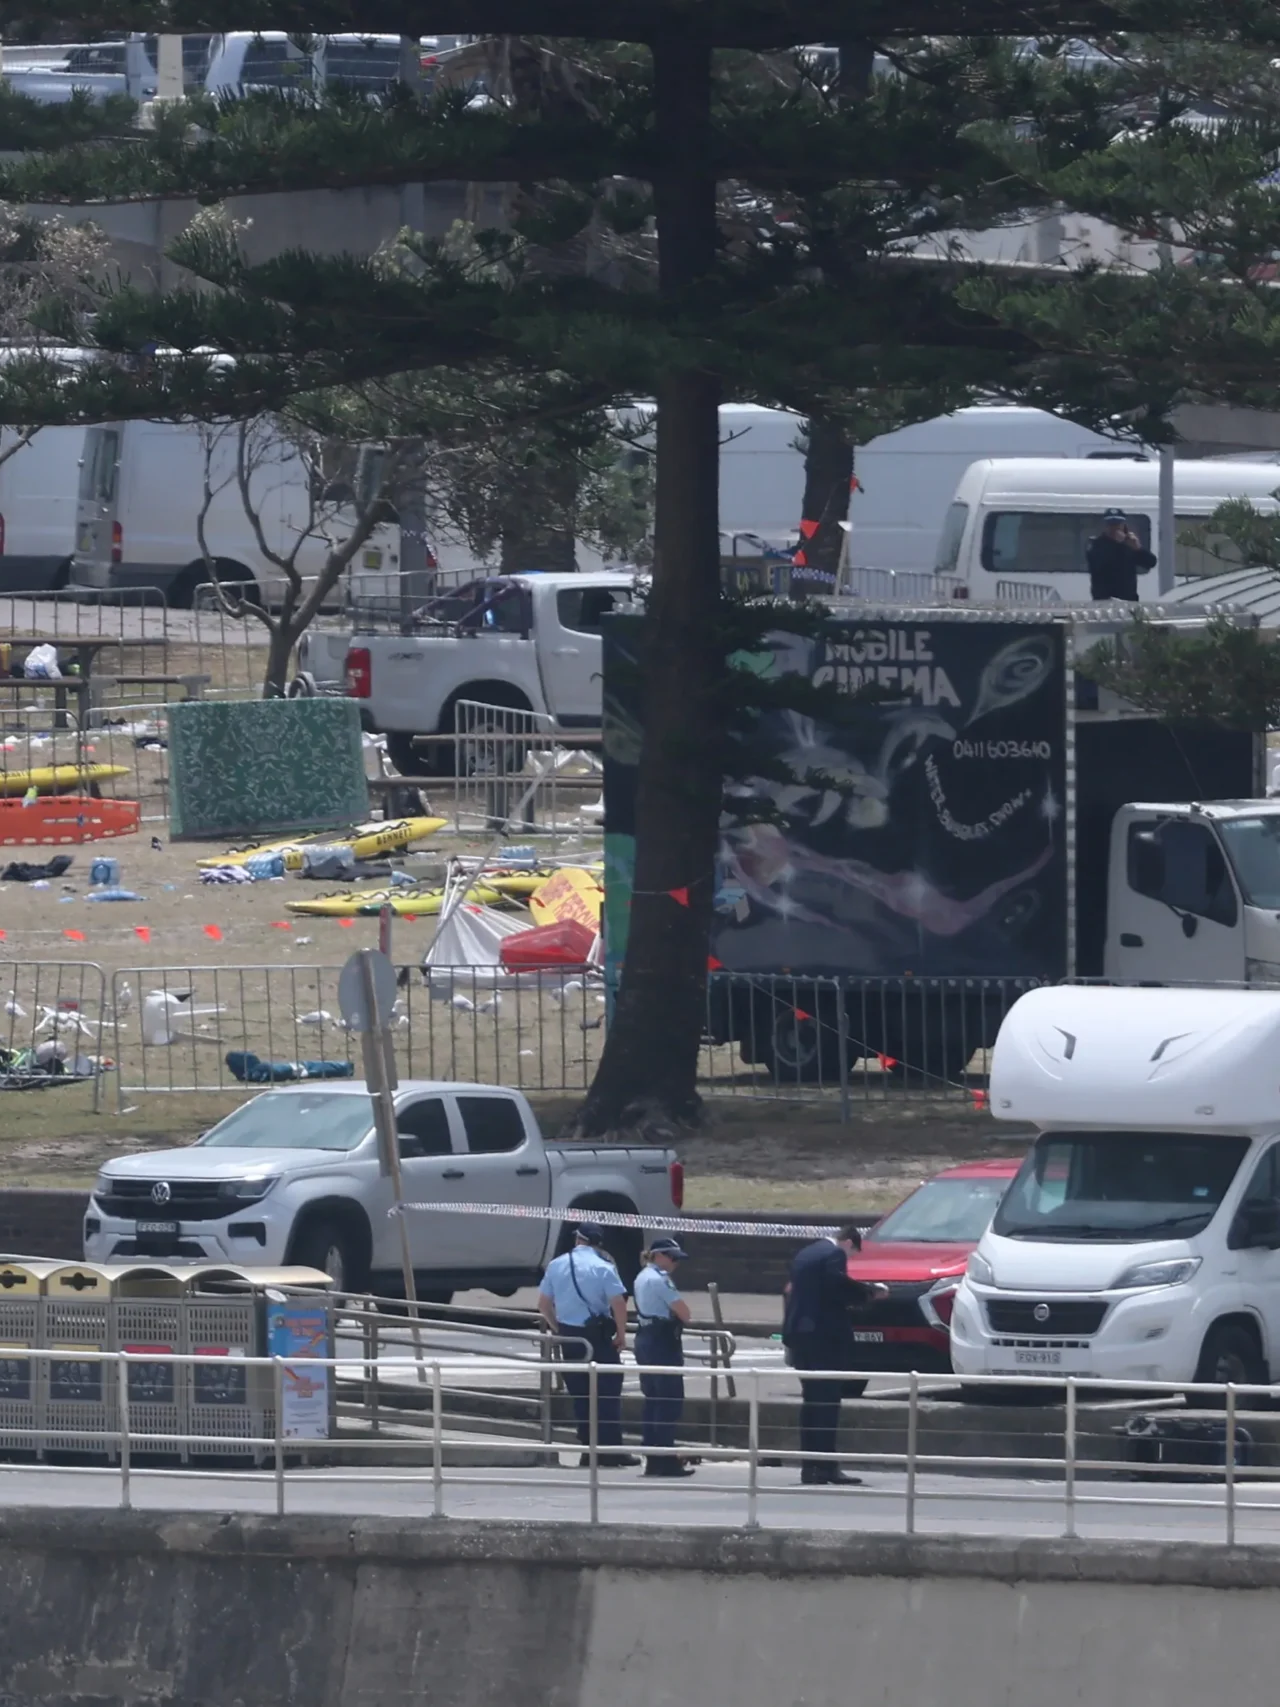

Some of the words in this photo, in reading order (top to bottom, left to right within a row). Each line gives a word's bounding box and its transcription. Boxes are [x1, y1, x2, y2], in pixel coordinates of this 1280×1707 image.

[825, 629, 933, 662] MOBILE
[812, 666, 961, 707] CINEMA
[376, 827, 413, 846] BENNETT
